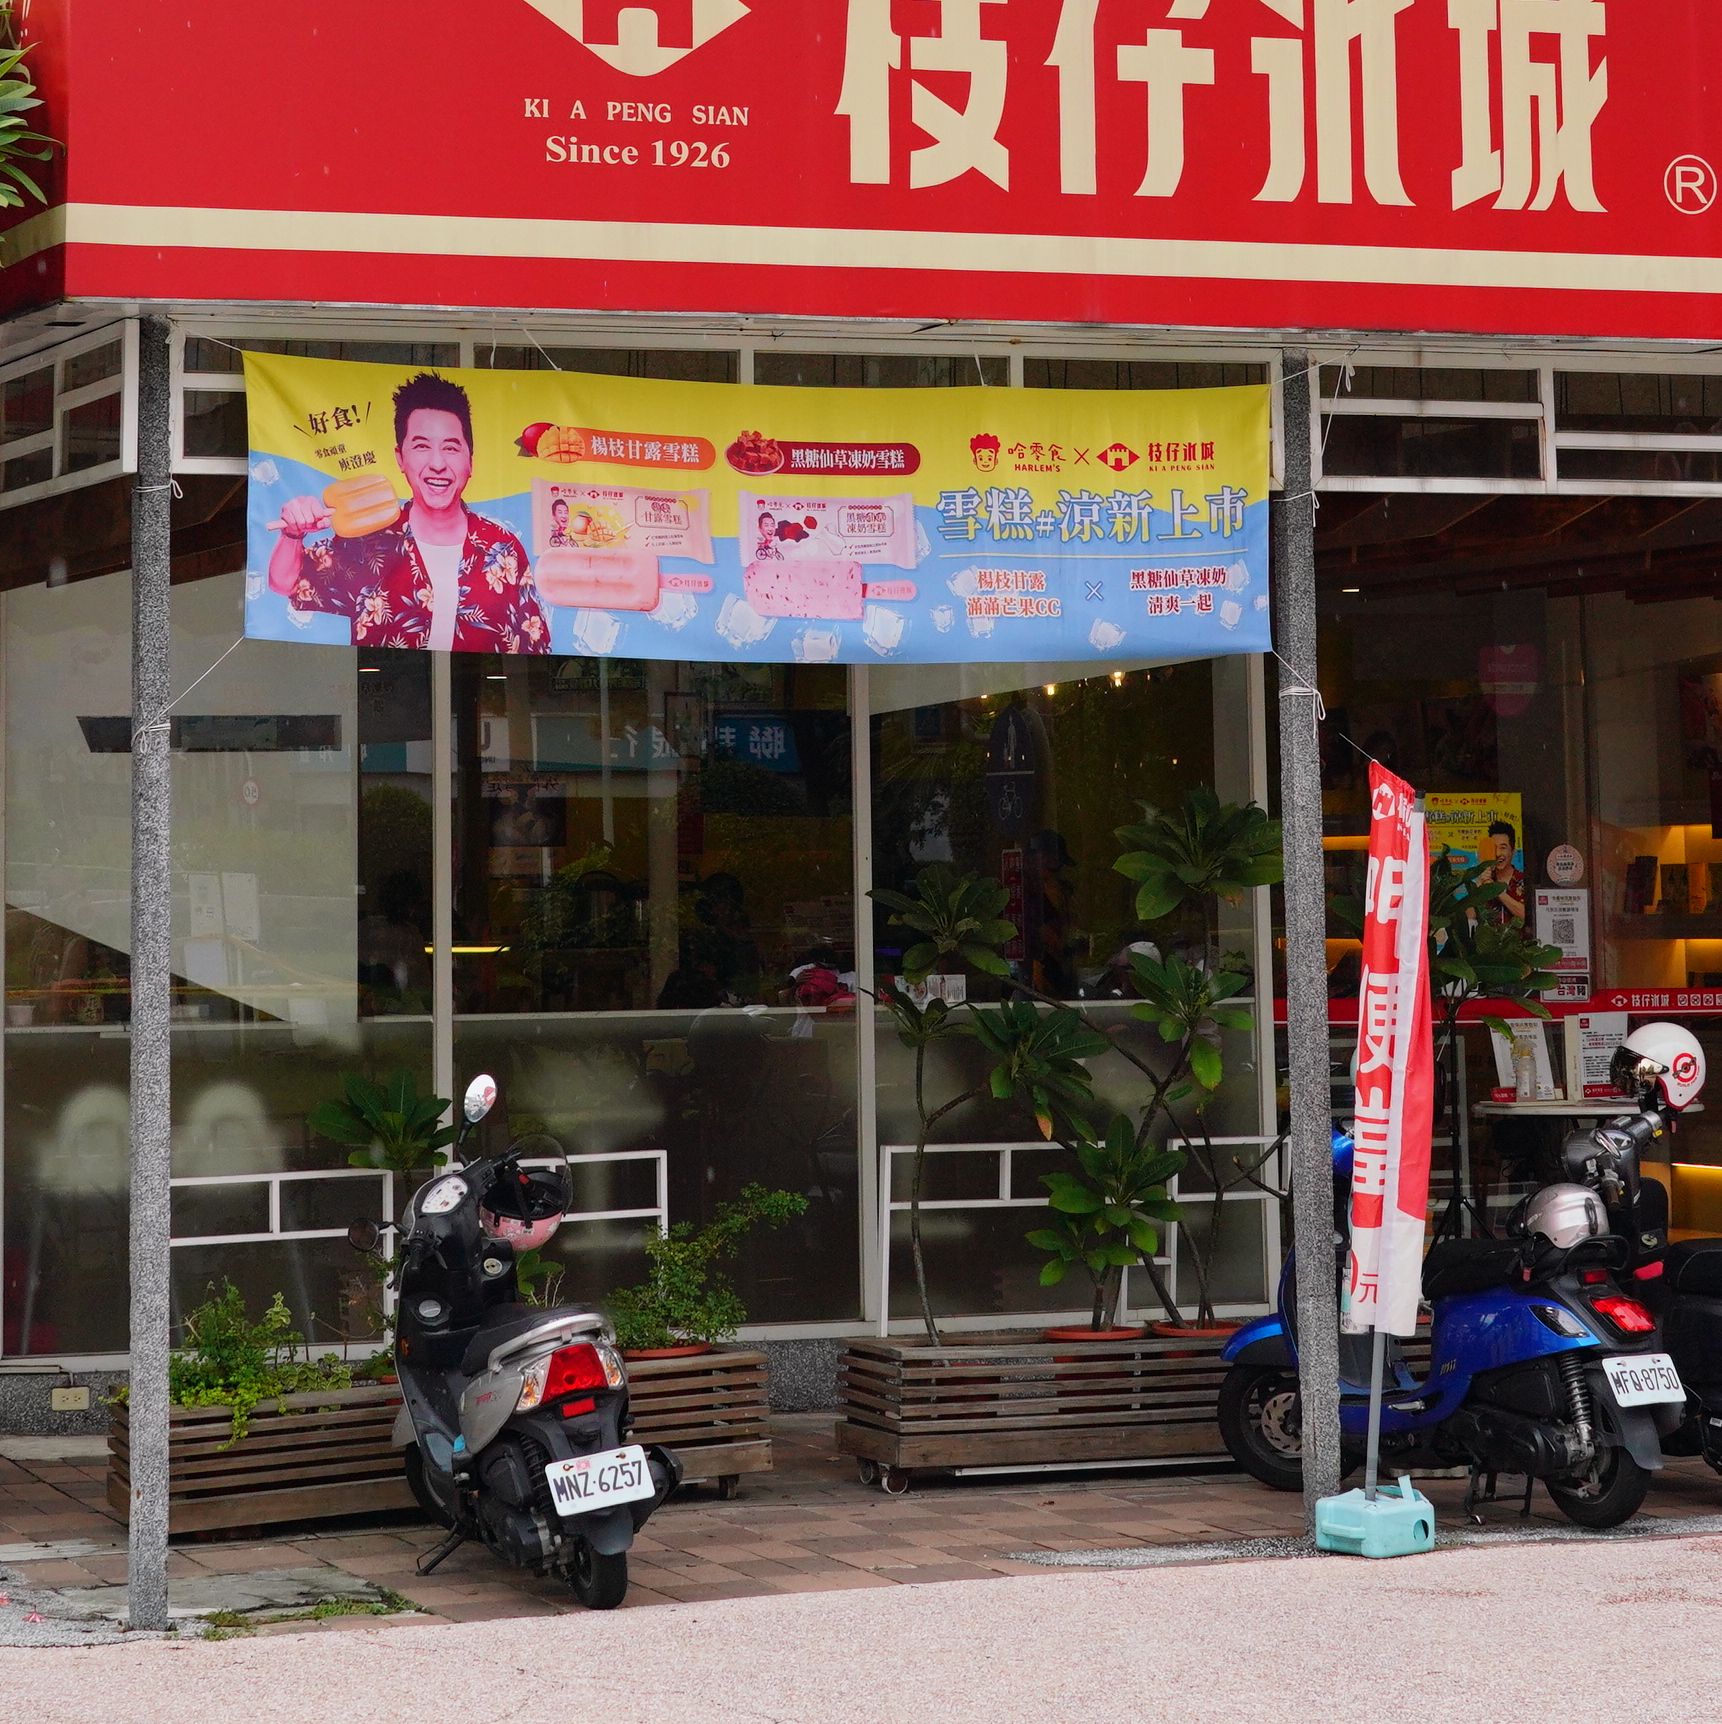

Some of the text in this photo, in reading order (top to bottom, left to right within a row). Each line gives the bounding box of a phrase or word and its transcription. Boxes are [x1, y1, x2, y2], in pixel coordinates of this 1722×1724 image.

[524, 98, 749, 126] KI A PENG SIAN
[545, 135, 730, 169] Since 1926
[590, 434, 701, 464] 楊枝甘露雪糕
[790, 446, 906, 470] 黑糖仙草凍奶雪糕
[1007, 441, 1067, 463] 哈零食
[1147, 441, 1215, 463] 枝仔冰城
[338, 450, 377, 472] 庾澄慶
[1014, 463, 1061, 473] HARLEM'S
[1170, 464, 1192, 472] PENG
[1195, 463, 1216, 472] SIAN
[937, 485, 1249, 544] 雪糕#涼新上市
[977, 570, 1046, 591] 楊枝甘露
[1130, 567, 1227, 590] 黑糖仙草凍奶
[967, 596, 1061, 617] 滿滿芒果CC
[1147, 593, 1213, 616] 清爽一起
[1631, 993, 1670, 1007] 枝仔冰城
